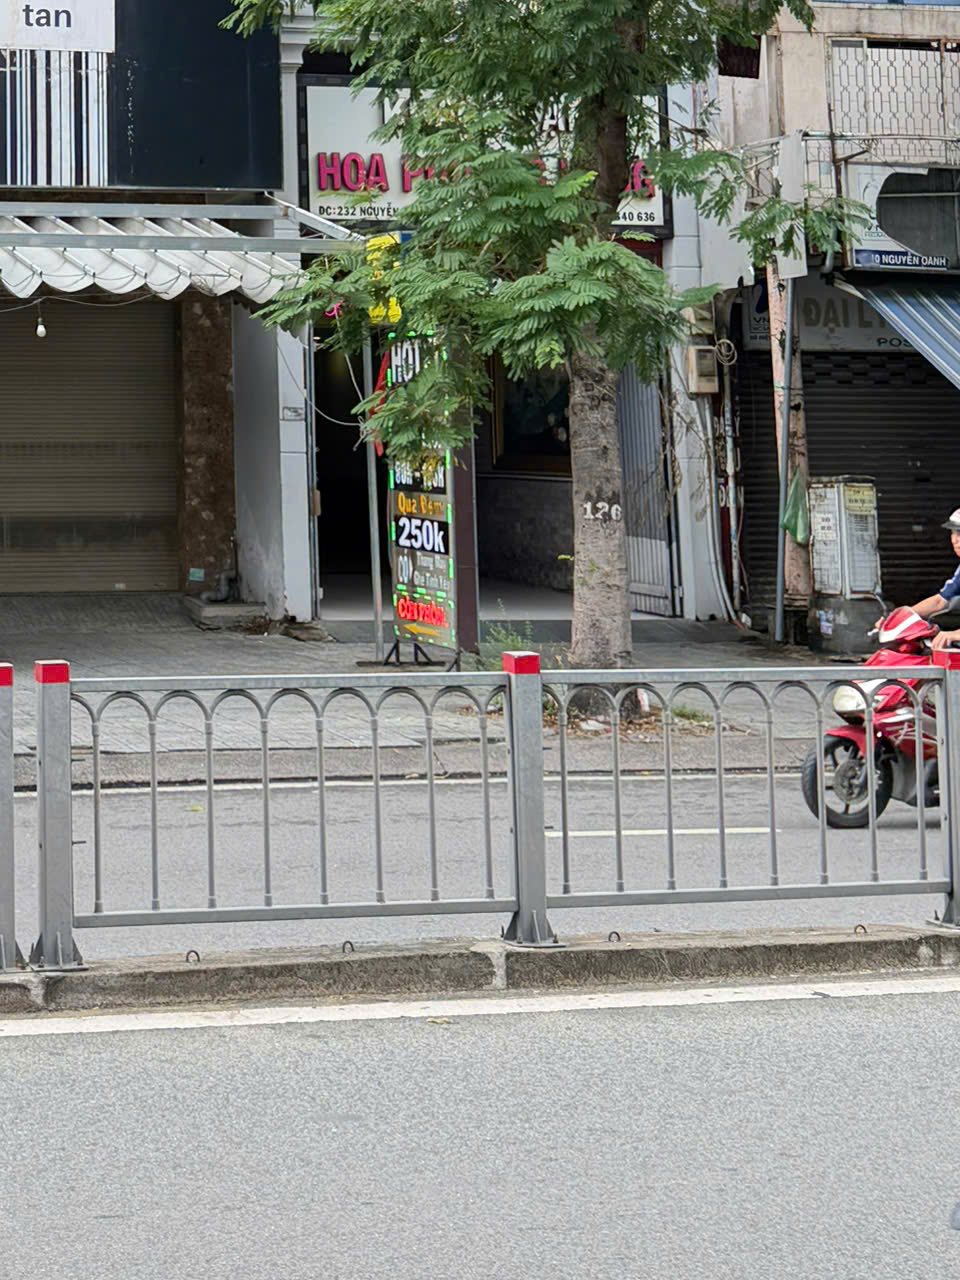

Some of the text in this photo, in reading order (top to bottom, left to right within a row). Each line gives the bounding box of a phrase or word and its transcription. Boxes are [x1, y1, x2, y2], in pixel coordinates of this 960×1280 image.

[22, 4, 72, 28] tan
[317, 152, 389, 193] HOA
[637, 211, 655, 222] 636
[921, 255, 947, 267] OANH
[583, 501, 621, 521] 126
